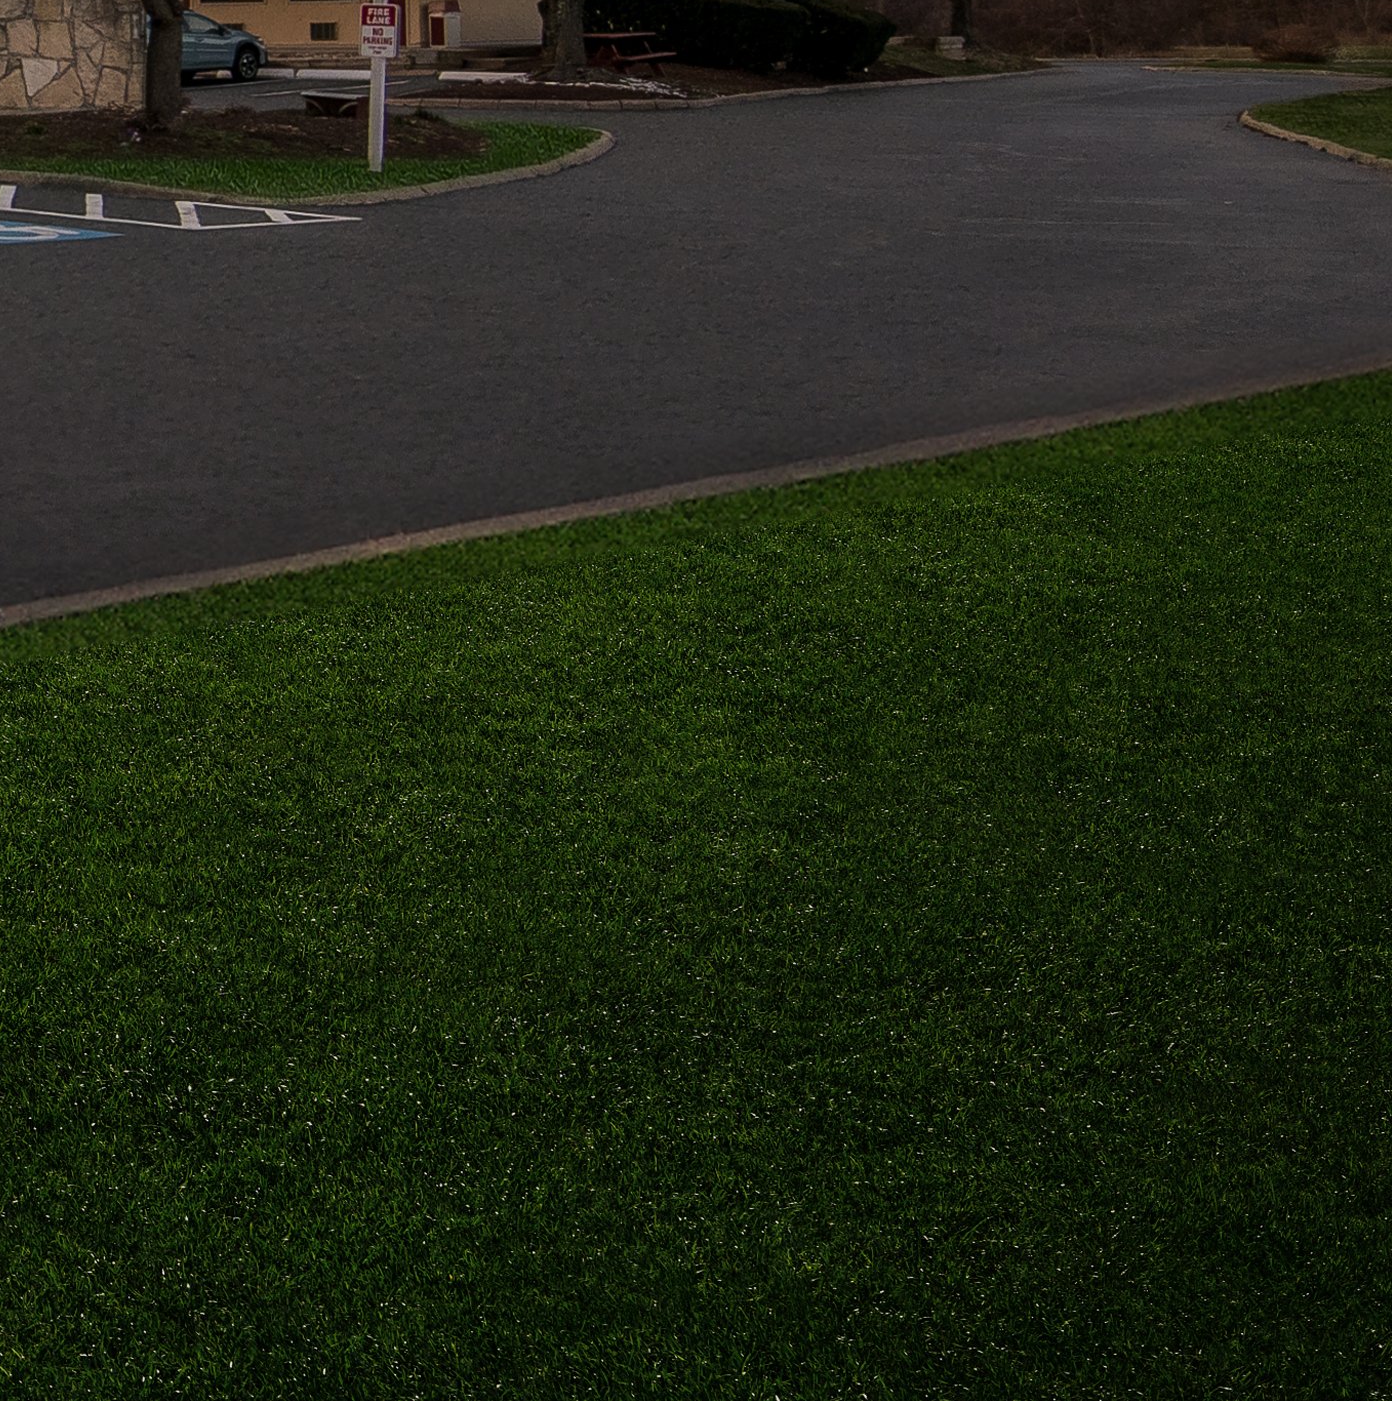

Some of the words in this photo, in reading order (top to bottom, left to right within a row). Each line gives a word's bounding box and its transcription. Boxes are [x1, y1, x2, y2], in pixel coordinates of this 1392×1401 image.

[367, 7, 390, 16] FIRE
[366, 16, 391, 25] LANE
[372, 27, 384, 36] NO
[362, 36, 393, 45] PARKING
